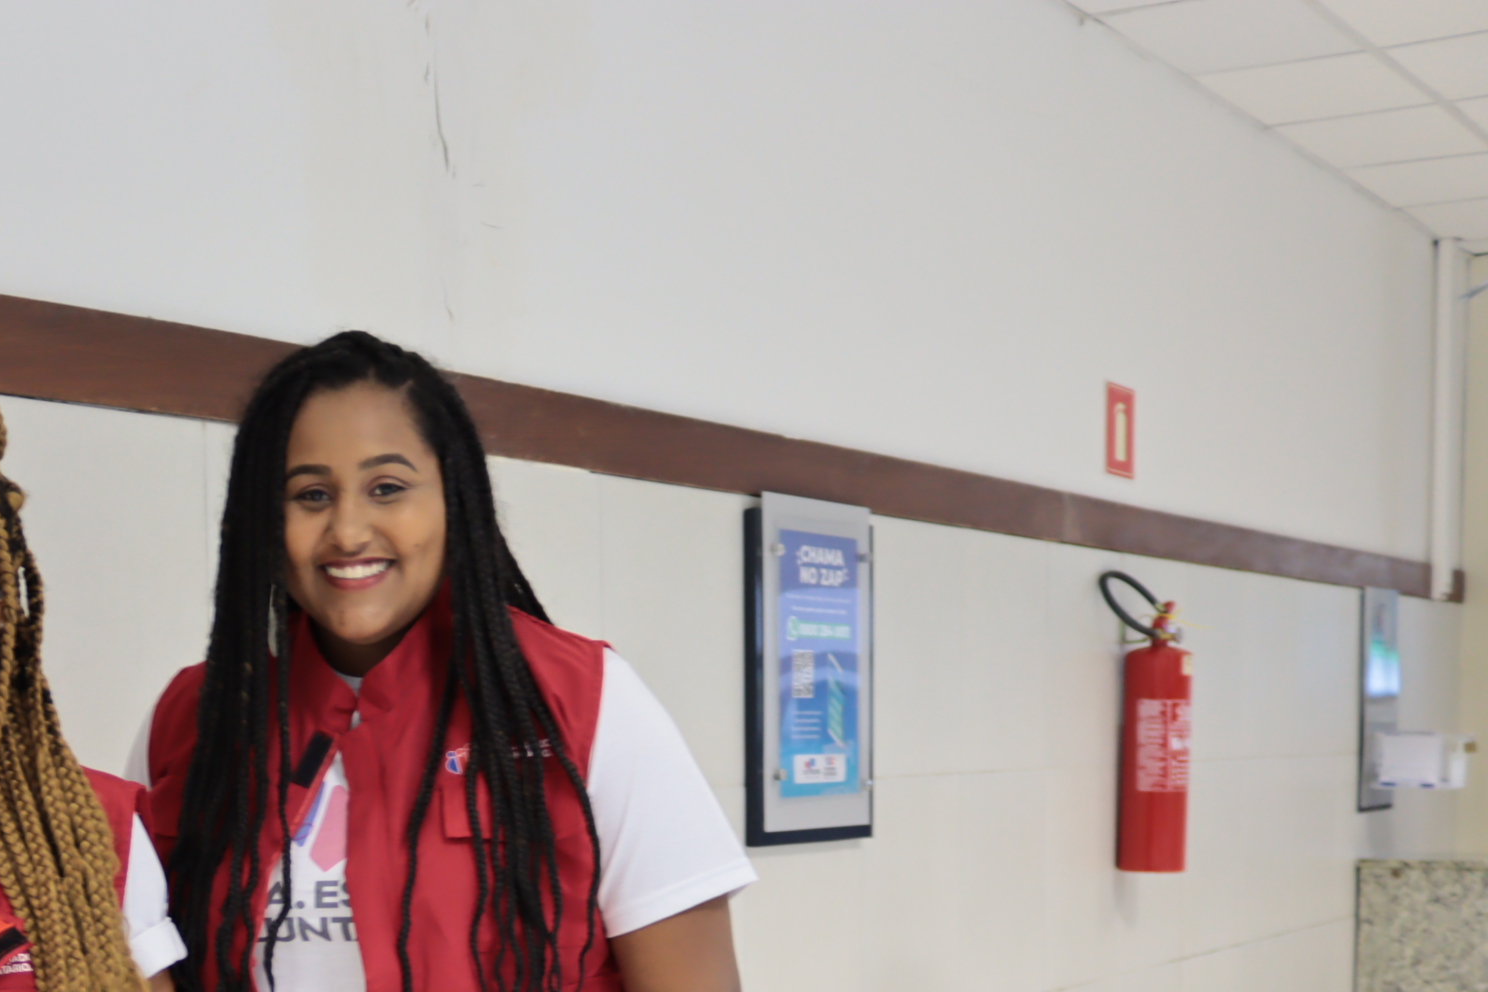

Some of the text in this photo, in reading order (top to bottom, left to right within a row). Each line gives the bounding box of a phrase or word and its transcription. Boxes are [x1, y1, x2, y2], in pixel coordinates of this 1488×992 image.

[799, 545, 845, 567] CHAMA
[799, 566, 844, 588] NO ZAP
